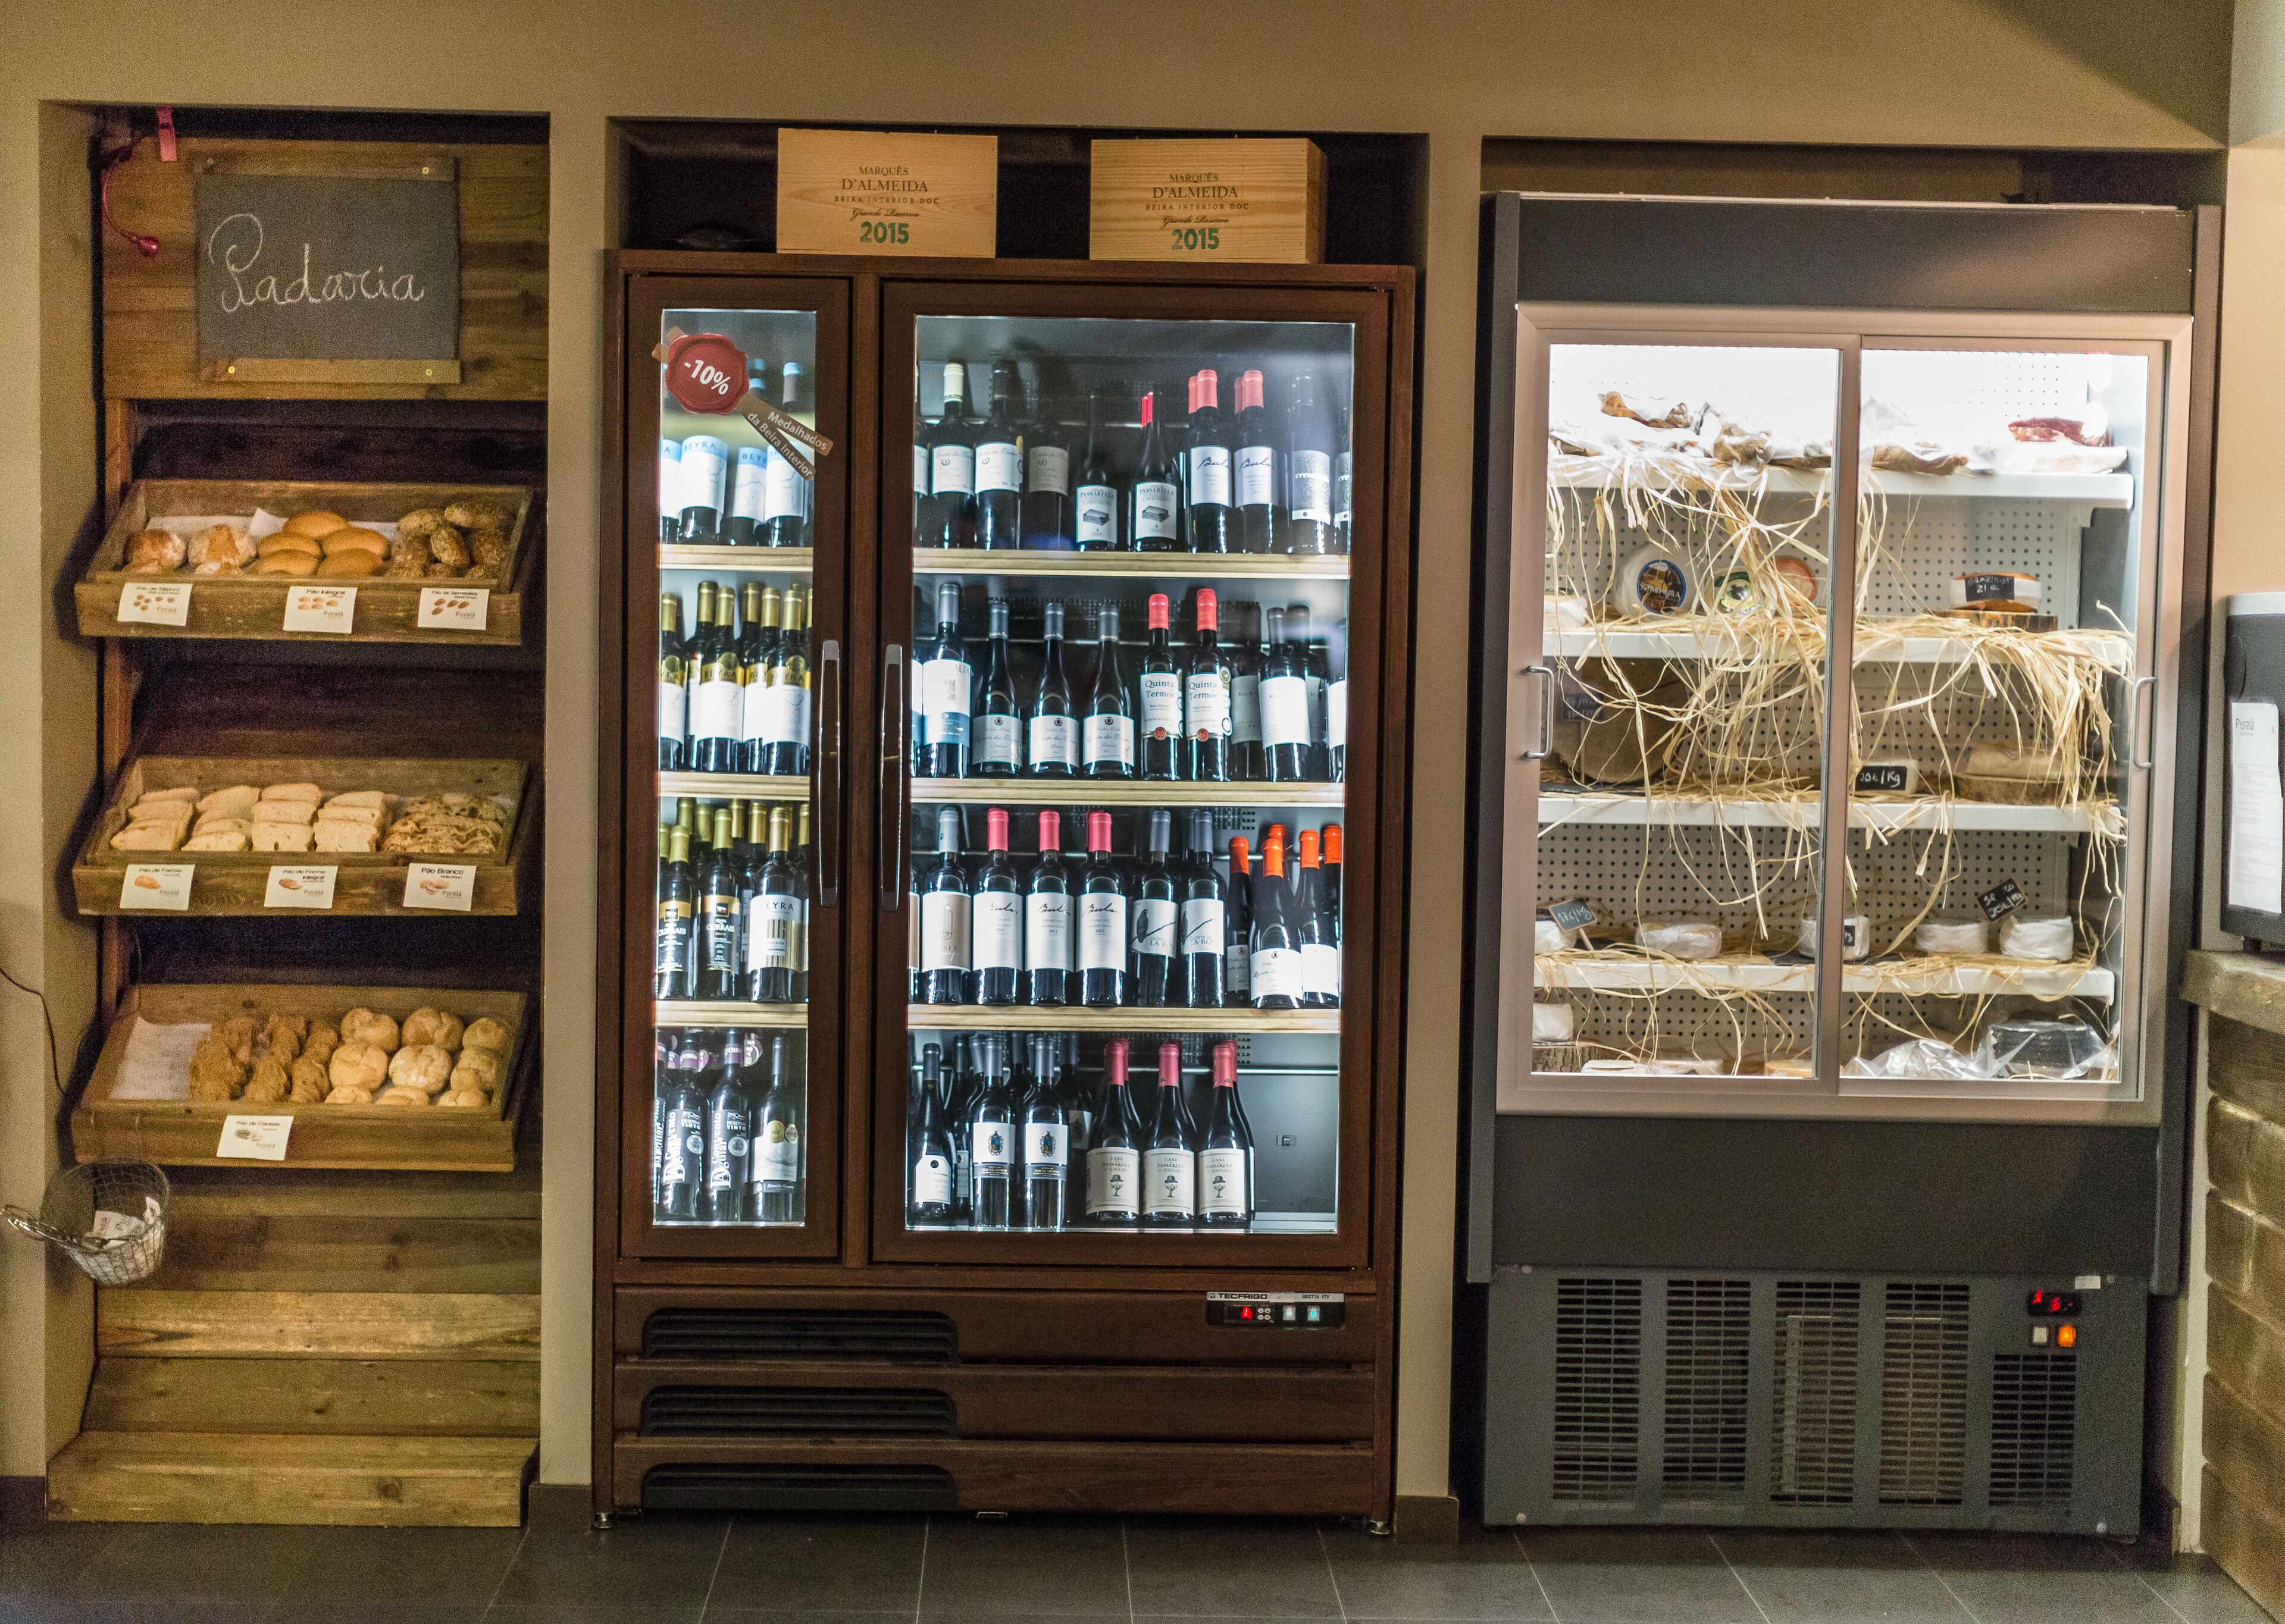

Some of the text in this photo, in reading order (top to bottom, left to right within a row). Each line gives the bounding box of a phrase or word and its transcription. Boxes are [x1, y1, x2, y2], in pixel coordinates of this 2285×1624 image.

[859, 165, 909, 176] MARQUÊS
[1170, 172, 1219, 183] MARQUÊS
[842, 178, 928, 192] D'ALMEIDA
[1152, 186, 1238, 199] D'ALMEIDA
[860, 221, 910, 244] 2015
[1171, 228, 1219, 250] 2015
[209, 213, 425, 313] Padaria
[684, 359, 731, 395] -10%
[768, 412, 828, 450] Medalhados
[747, 413, 813, 477] da Beira Interior
[1145, 679, 1174, 688] Quinta
[1189, 681, 1217, 690] Quinta
[1190, 692, 1217, 700] Termos
